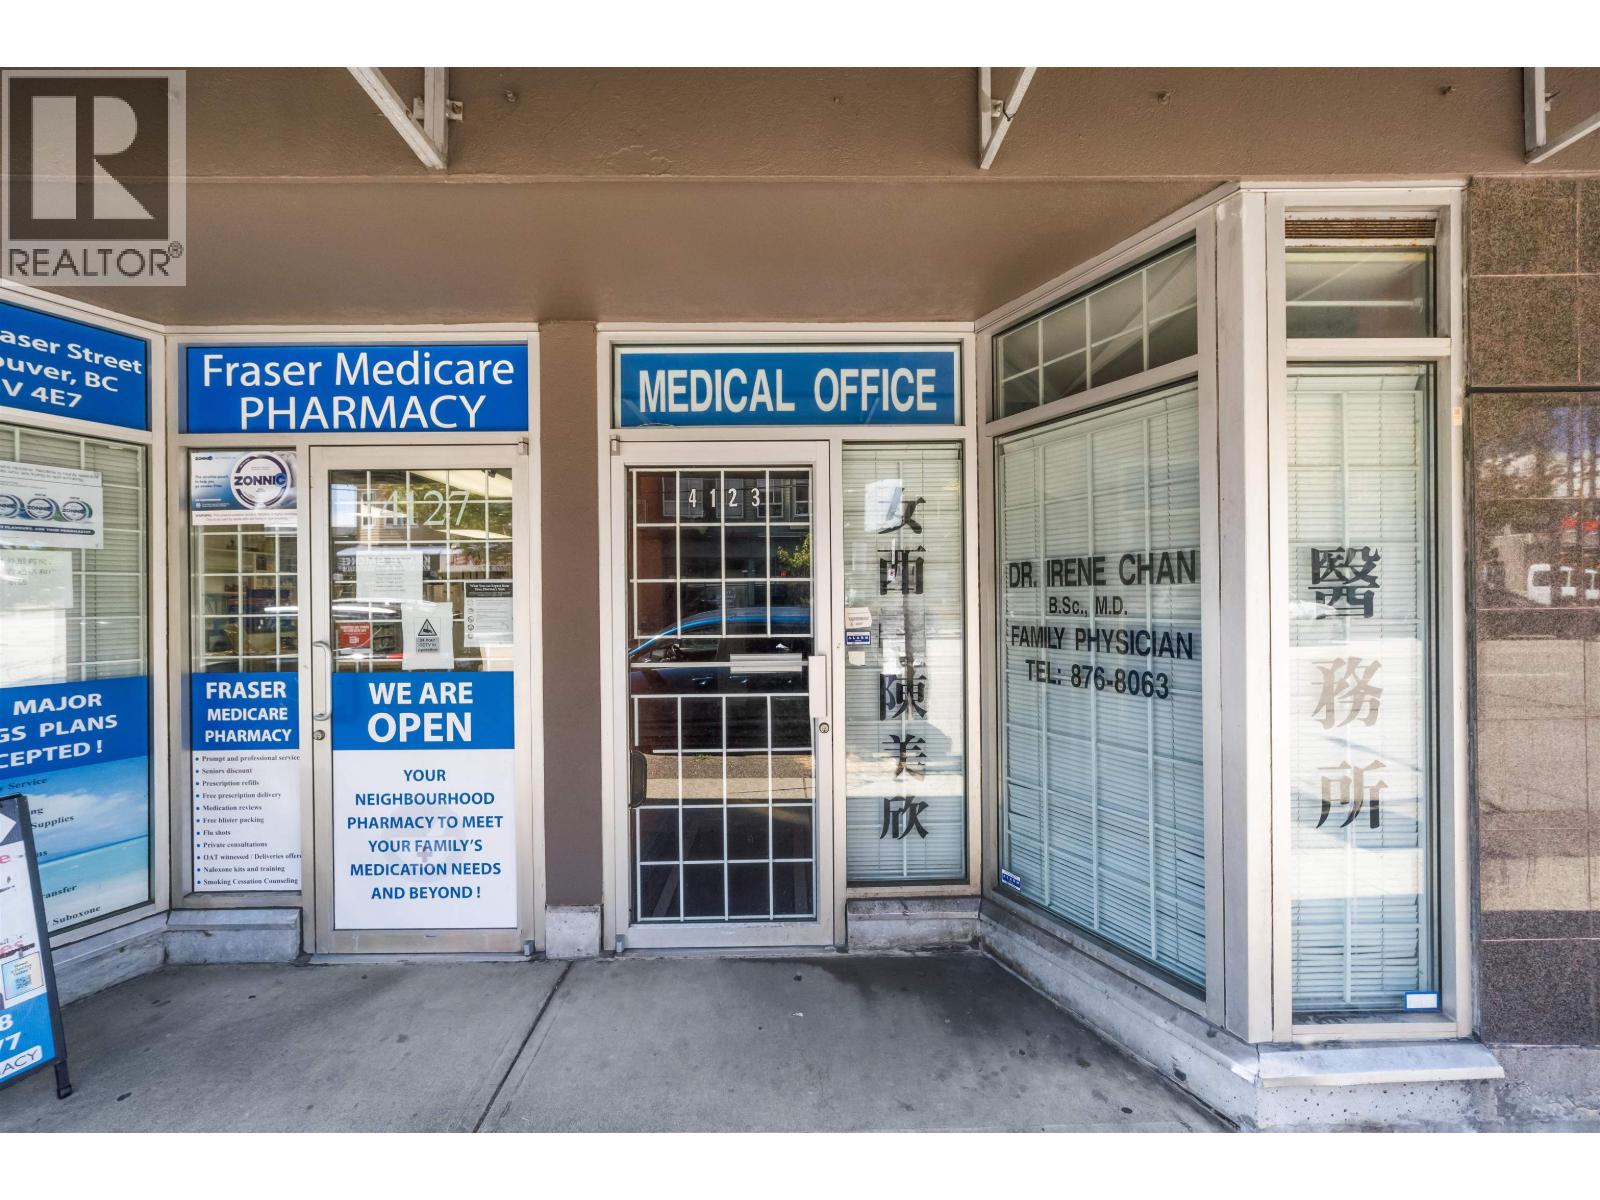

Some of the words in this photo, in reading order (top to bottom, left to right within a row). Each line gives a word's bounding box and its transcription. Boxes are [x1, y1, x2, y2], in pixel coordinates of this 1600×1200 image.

[67, 344, 142, 375] Street
[203, 354, 322, 387] Fraser
[335, 350, 514, 386] Medicare
[85, 371, 119, 392] BC
[639, 368, 795, 413] MEDICAL
[814, 367, 937, 412] OFFICE
[1, 379, 24, 397] V
[30, 386, 82, 408] 4E7
[240, 394, 486, 431] PHARMACY
[234, 474, 287, 486] ZONNIC
[381, 490, 470, 526] 4127
[1009, 562, 1037, 588] DR.
[1046, 556, 1106, 587] IRENE
[1119, 550, 1196, 586] CHAN
[1049, 596, 1088, 618] B.Sc.,
[1095, 596, 1128, 615] M.D.
[1011, 625, 1065, 650] FAMILY
[1075, 627, 1193, 660] PHYSICIAN
[1025, 659, 1062, 685] TEL:
[1070, 664, 1169, 699] 876-8063
[1308, 545, 1389, 829] 醫務所
[206, 681, 287, 699] FRASER
[368, 682, 411, 705] WE
[419, 682, 473, 704] ARE
[13, 693, 102, 716] MAJOR
[207, 707, 288, 721] MEDICARE
[39, 714, 118, 738] PLANS
[205, 729, 292, 743] PHARMACY
[367, 712, 472, 743] OPEN
[202, 755, 225, 763] Prompt
[240, 754, 277, 763] professional
[8, 778, 48, 790] Service
[403, 769, 446, 781] YOUR
[218, 792, 256, 800] prescription
[257, 791, 281, 799] delivery
[355, 792, 495, 806] NEIGHBOURHOOD
[31, 816, 74, 829] Supplies
[239, 816, 264, 824] packing
[347, 816, 434, 829] PHARMACY
[437, 816, 458, 828] TO
[462, 815, 504, 828] MEET
[368, 840, 411, 853] YOUR
[415, 839, 483, 852] FAMILY'S
[350, 863, 447, 876] MEDICATION
[451, 862, 501, 875] NEEDS
[371, 887, 405, 900] AND
[409, 886, 473, 899] BEYOND
[53, 906, 101, 926] Suboxone
